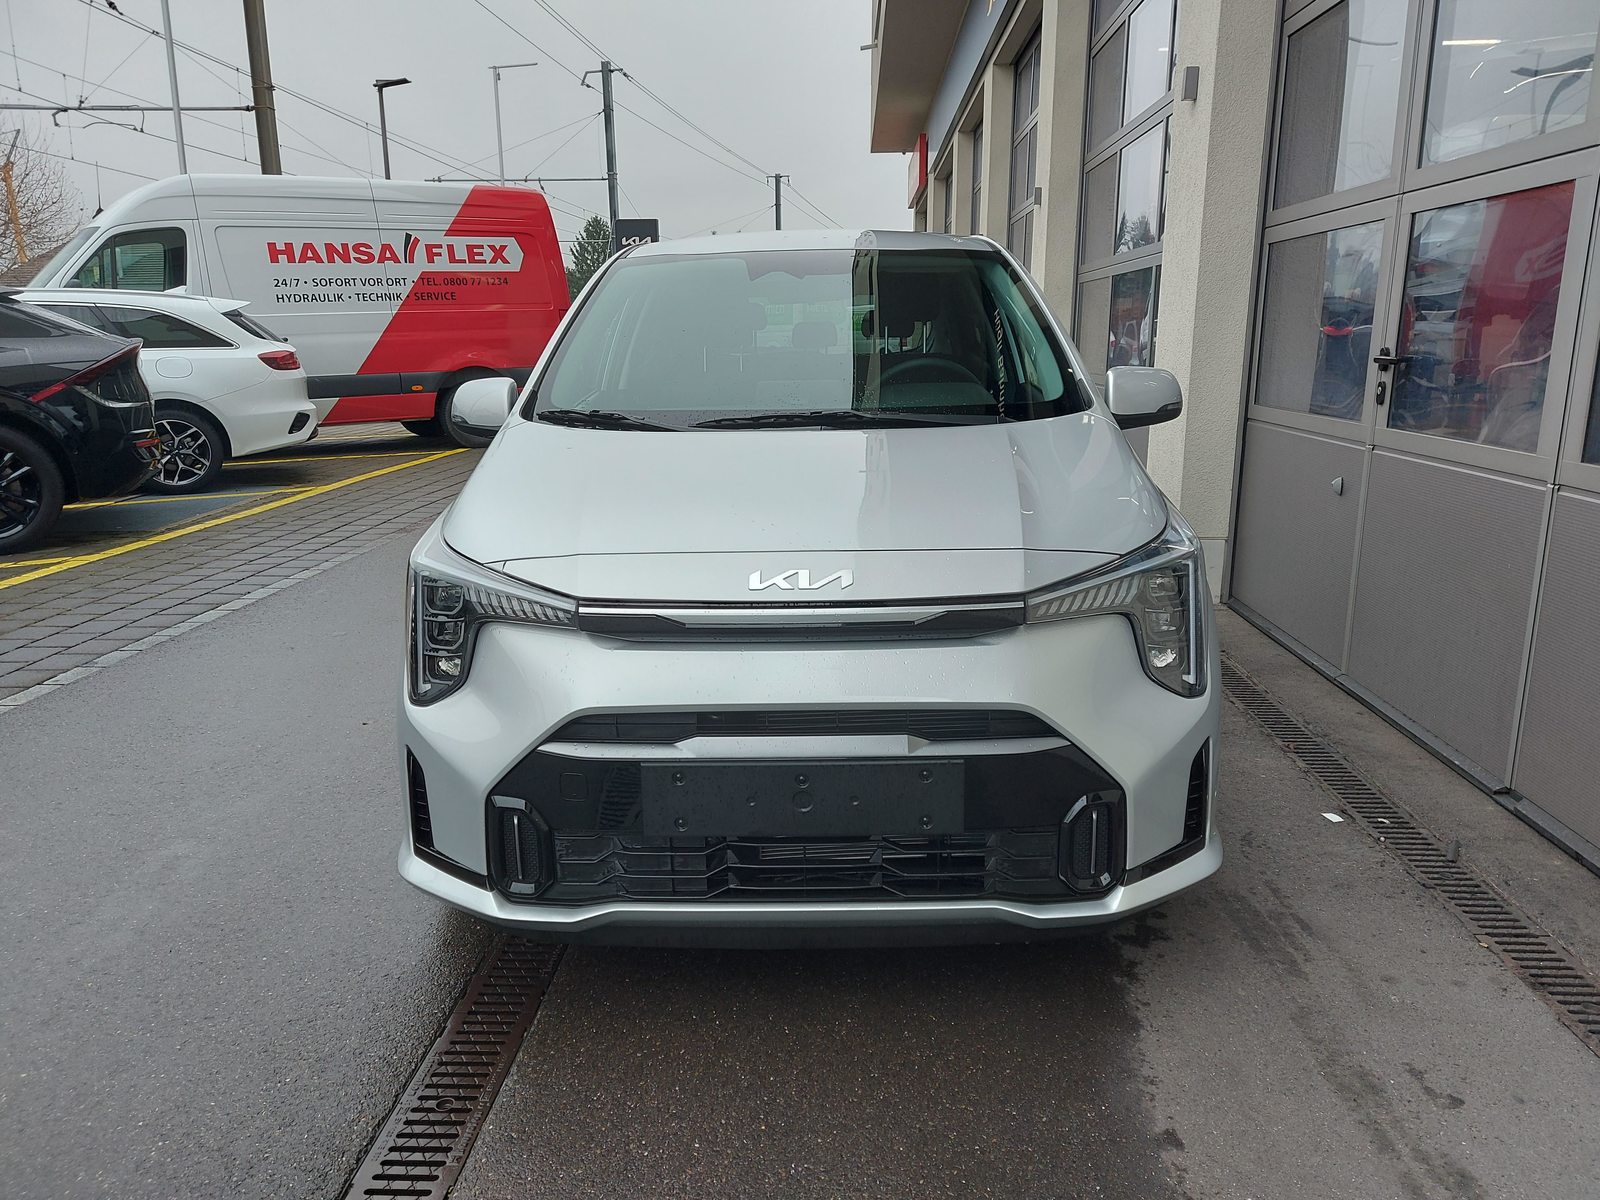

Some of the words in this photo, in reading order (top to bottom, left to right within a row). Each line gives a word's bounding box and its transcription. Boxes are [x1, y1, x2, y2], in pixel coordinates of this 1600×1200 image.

[266, 242, 402, 265] HANSA
[424, 243, 511, 265] FLEX
[273, 278, 300, 288] 24/7
[312, 277, 357, 288] SOFORT
[359, 277, 384, 287] VOR
[386, 277, 408, 287] ORT
[420, 277, 441, 286] TEL.
[444, 277, 468, 286] 0800
[471, 277, 482, 286] 77
[486, 276, 509, 286] 1234
[275, 292, 345, 303] HYDRAULIK
[355, 291, 403, 302] TECHNIK
[414, 291, 457, 301] SERVICE
[748, 569, 854, 591] KIA
